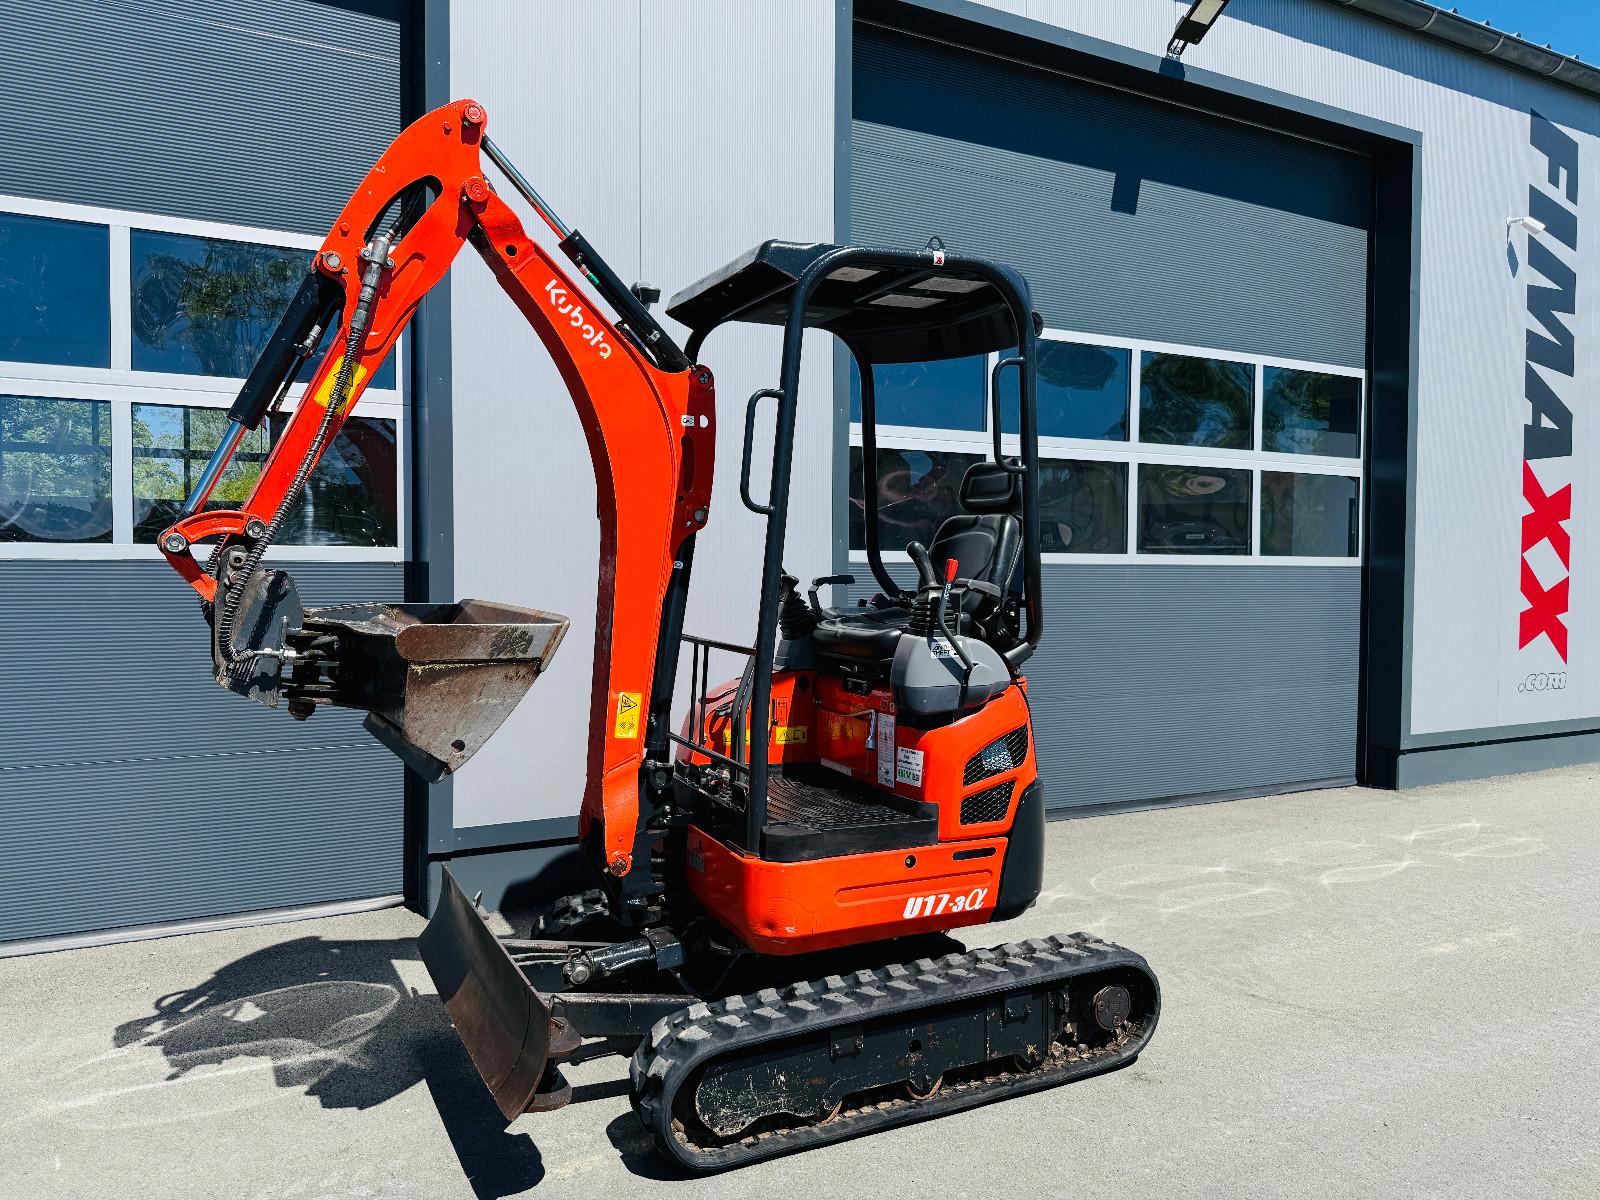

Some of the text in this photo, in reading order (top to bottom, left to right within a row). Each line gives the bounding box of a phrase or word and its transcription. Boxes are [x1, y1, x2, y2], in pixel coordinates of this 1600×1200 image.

[545, 279, 612, 360] Kubota
[1519, 107, 1579, 666] FIMAXX
[1518, 671, 1567, 693] .com
